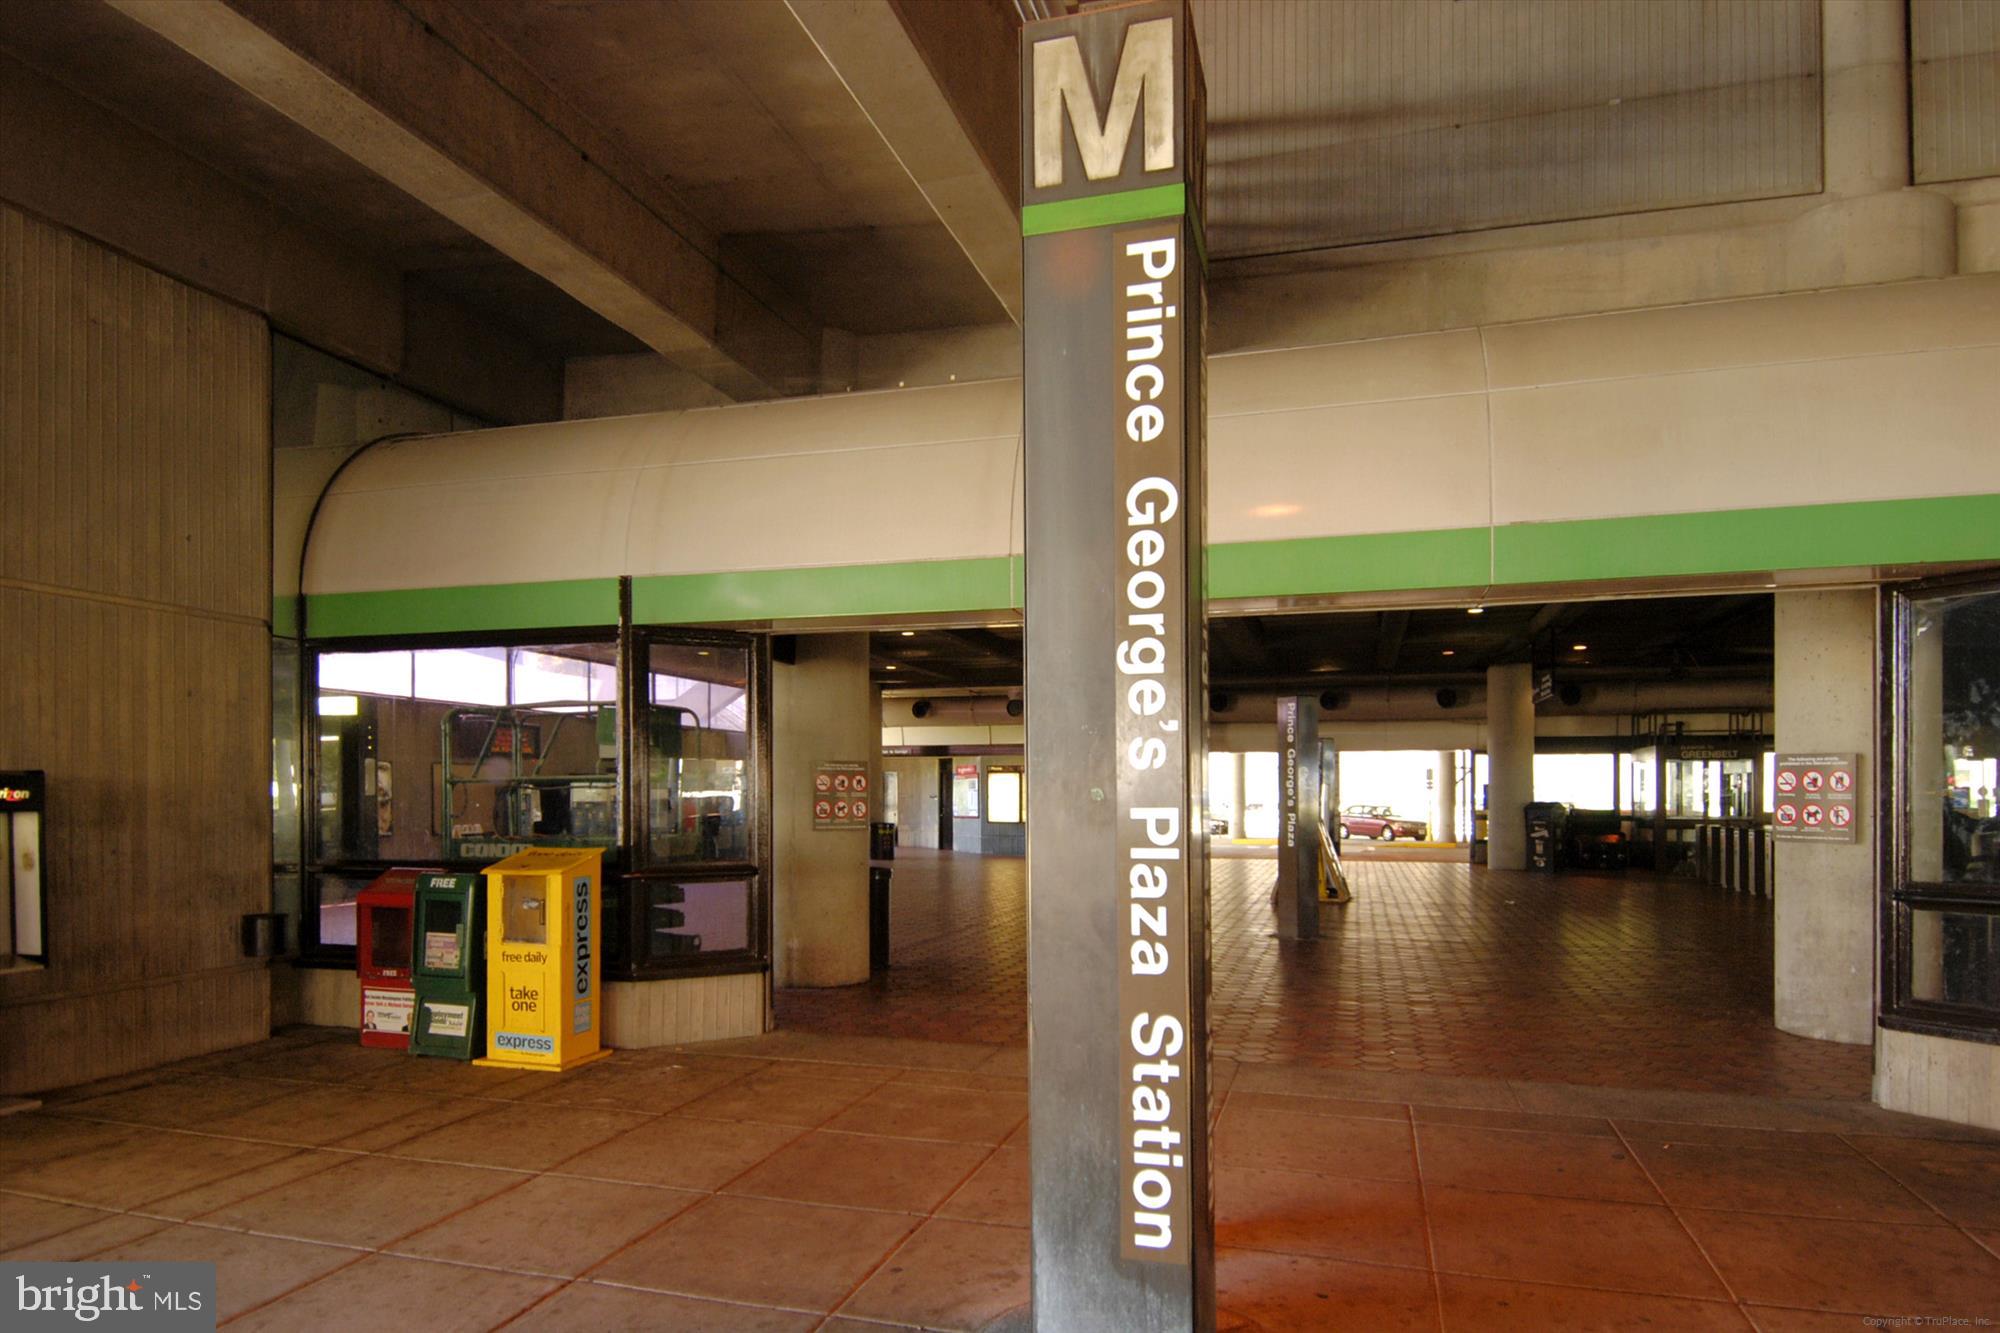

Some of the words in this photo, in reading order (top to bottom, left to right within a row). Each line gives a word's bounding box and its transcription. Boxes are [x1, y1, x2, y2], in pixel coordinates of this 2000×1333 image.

[1033, 17, 1174, 189] M
[1126, 237, 1177, 443] Prince
[1116, 476, 1180, 771] George's
[1287, 702, 1296, 742] Prince
[1285, 747, 1296, 808] George's
[1287, 812, 1296, 848] Plaza
[430, 877, 457, 889] FREE
[1129, 806, 1180, 976] Plaza
[501, 951, 522, 963] free
[523, 952, 548, 964] daily
[576, 881, 591, 994] express
[510, 986, 539, 1001] take
[511, 1000, 537, 1013] one
[497, 1034, 552, 1051] express
[1130, 1012, 1184, 1250] Station
